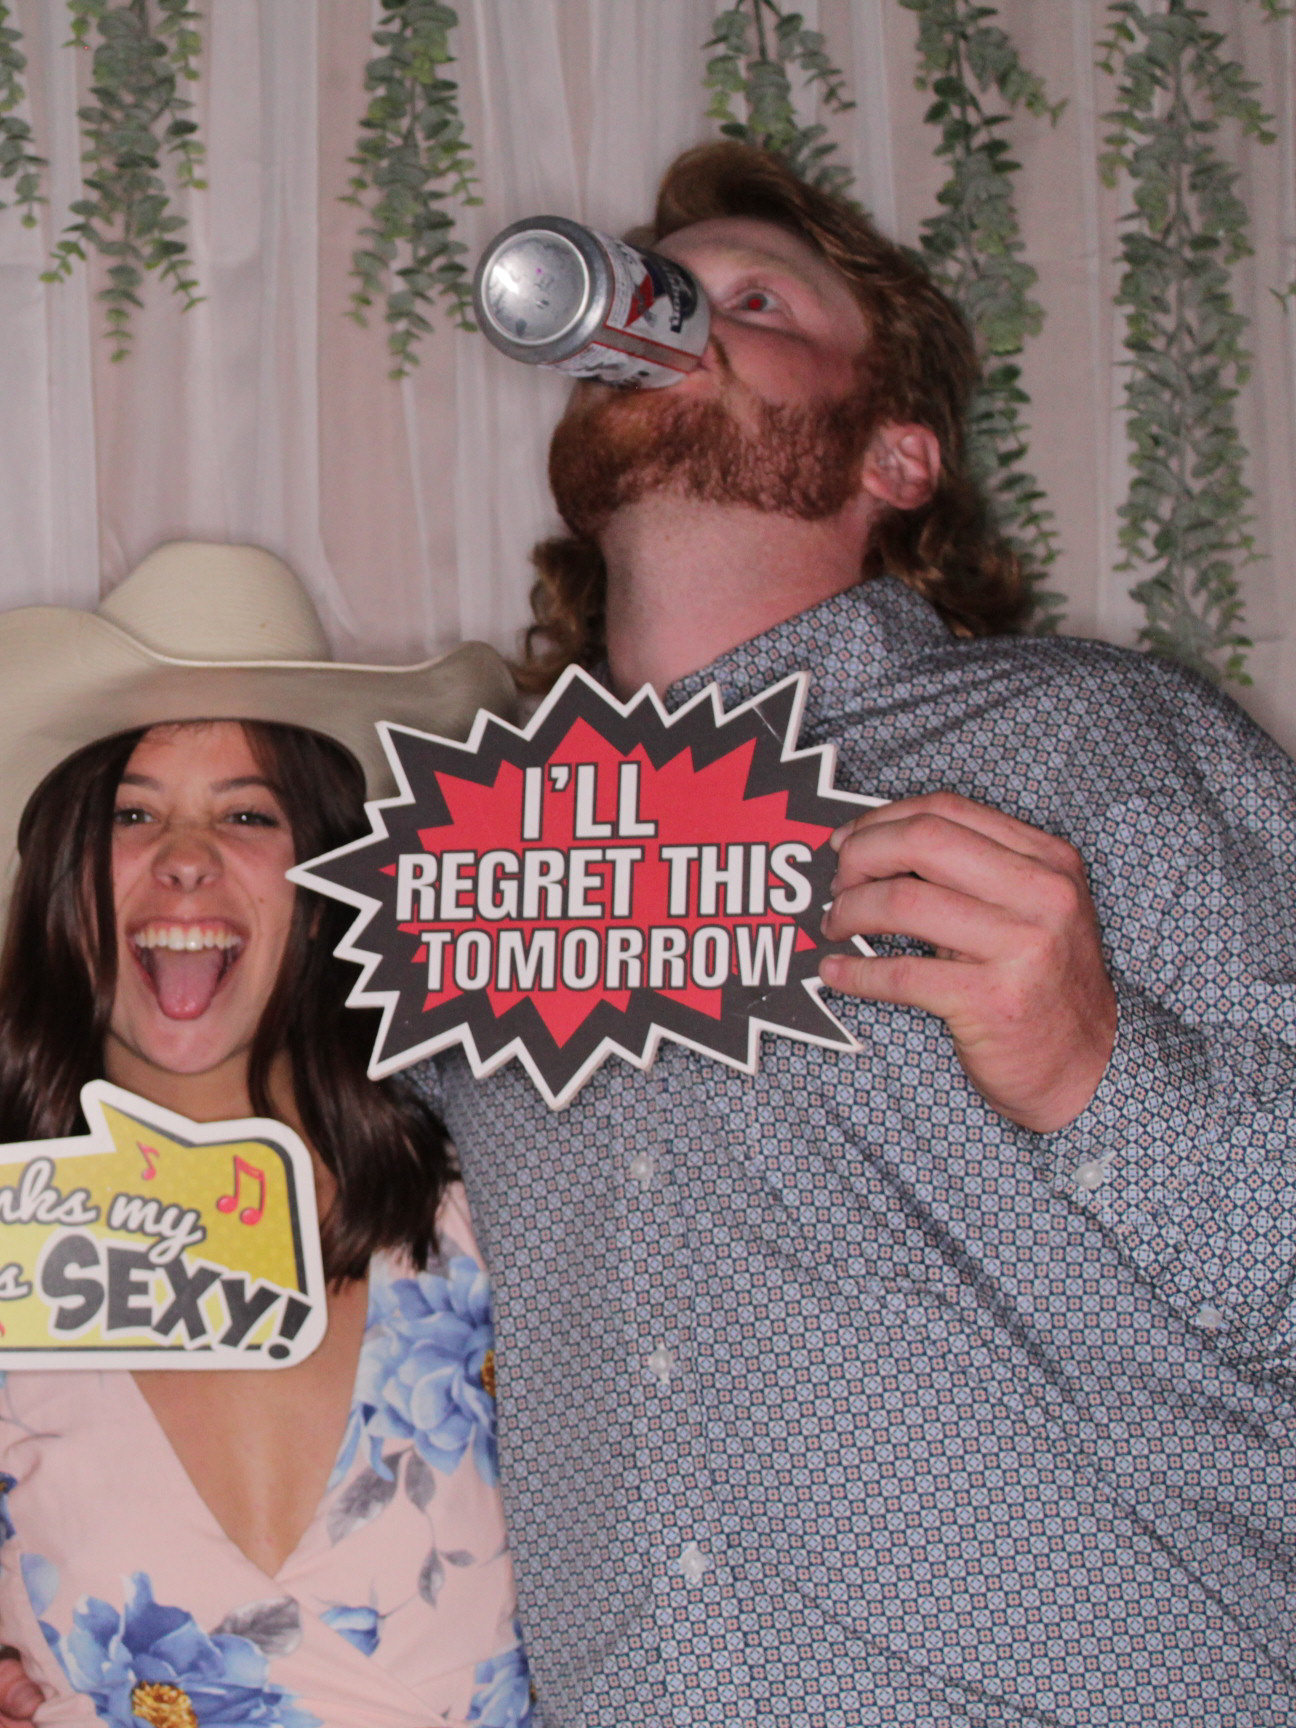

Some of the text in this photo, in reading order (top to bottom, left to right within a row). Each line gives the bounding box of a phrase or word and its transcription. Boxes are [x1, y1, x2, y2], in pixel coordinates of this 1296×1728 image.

[522, 763, 657, 841] I'LL
[396, 843, 812, 922] REGRET THIS
[420, 926, 795, 991] TOMORROW
[108, 1192, 204, 1264] my
[40, 1234, 312, 1360] SEXY!
